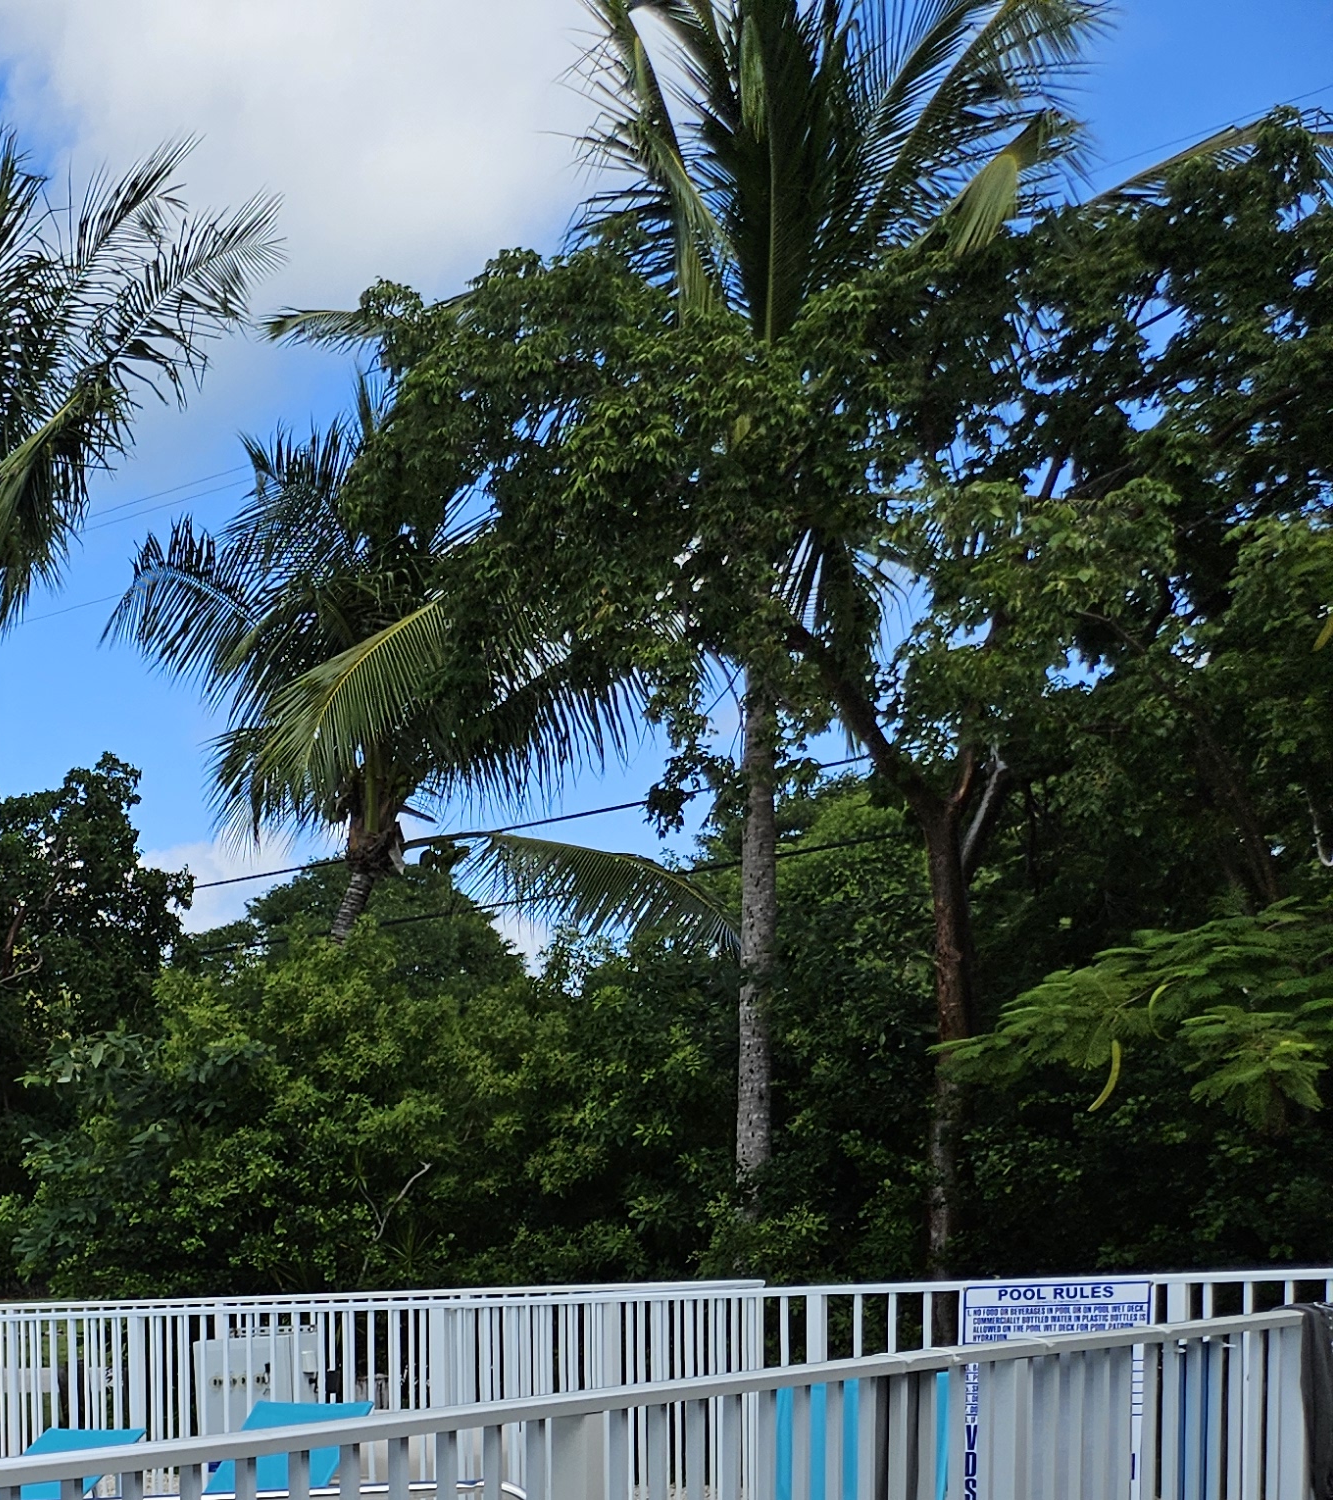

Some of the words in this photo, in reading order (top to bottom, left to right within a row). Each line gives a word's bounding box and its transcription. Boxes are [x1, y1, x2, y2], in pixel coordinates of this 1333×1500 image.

[998, 1288, 1046, 1301] POOL
[1053, 1286, 1114, 1300] RULES
[974, 1308, 982, 1316] NO
[983, 1308, 999, 1316] FOOD
[1000, 1308, 1009, 1316] OR
[1010, 1307, 1046, 1316] BEVERAGES
[1046, 1307, 1053, 1315] IN
[1055, 1306, 1070, 1314] POOL
[1072, 1306, 1081, 1314] OR
[1083, 1306, 1092, 1314] ON
[1093, 1305, 1109, 1313] POOL
[1111, 1305, 1125, 1313] WET
[973, 1316, 1020, 1325] COMMERCIALLY
[1022, 1316, 1049, 1324] BOTTLED
[1050, 1315, 1072, 1323] WATER
[1082, 1314, 1109, 1322] PLASTIC
[1110, 1313, 1138, 1322] BOTTLES
[1139, 1313, 1146, 1321] IS
[973, 1325, 1001, 1333] ALLOWED
[1002, 1325, 1011, 1333] ON
[1026, 1324, 1041, 1332] POOL
[1043, 1324, 1057, 1332] WET
[1058, 1323, 1075, 1332] DECK
[1076, 1323, 1089, 1332] FOR
